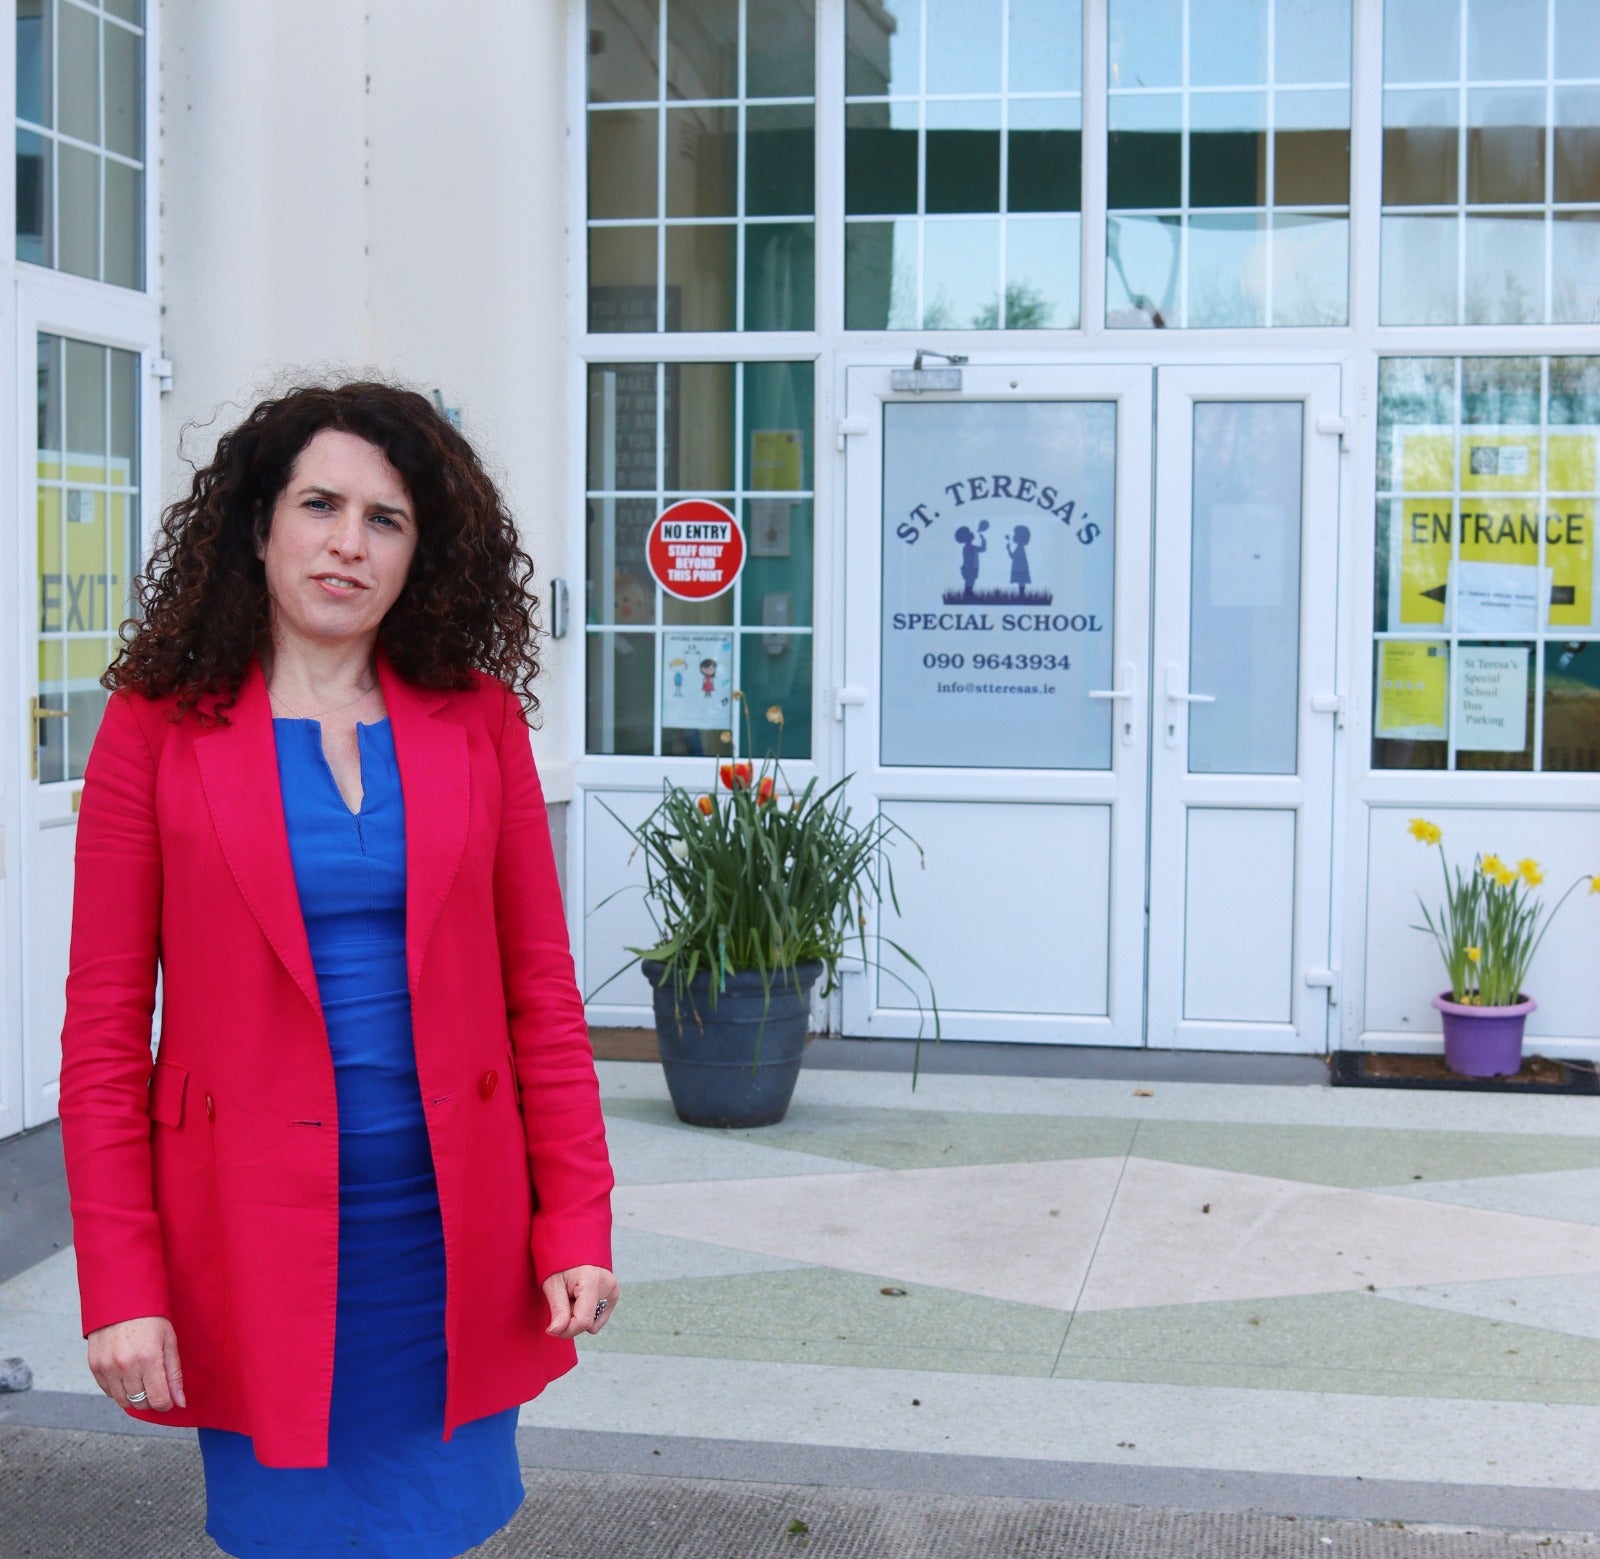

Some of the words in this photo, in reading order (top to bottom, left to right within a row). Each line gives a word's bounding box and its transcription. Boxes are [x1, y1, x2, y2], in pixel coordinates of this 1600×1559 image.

[896, 504, 940, 545] ST.
[945, 475, 1101, 545] TERESA'S
[664, 523, 682, 539] NO
[686, 523, 727, 539] ENTRY
[1411, 513, 1584, 544] ENTRANCE
[667, 544, 698, 558] STAFF
[698, 544, 724, 558] ONLY
[675, 557, 716, 570] BEYOND
[667, 569, 692, 582] THIS
[692, 569, 724, 582] POINT
[41, 573, 118, 632] EXIT
[892, 613, 994, 631] SPECIAL
[1002, 614, 1103, 632] SCHOOL
[922, 653, 965, 669] 090
[972, 654, 1071, 671] 9643934
[1464, 657, 1474, 669] St
[1476, 658, 1518, 669] Teresa's
[1464, 673, 1500, 685] Special
[937, 682, 1056, 694] info@stteresas.ie
[1464, 686, 1499, 697] School
[1463, 700, 1483, 711] Bus
[1466, 715, 1505, 728] Parking
